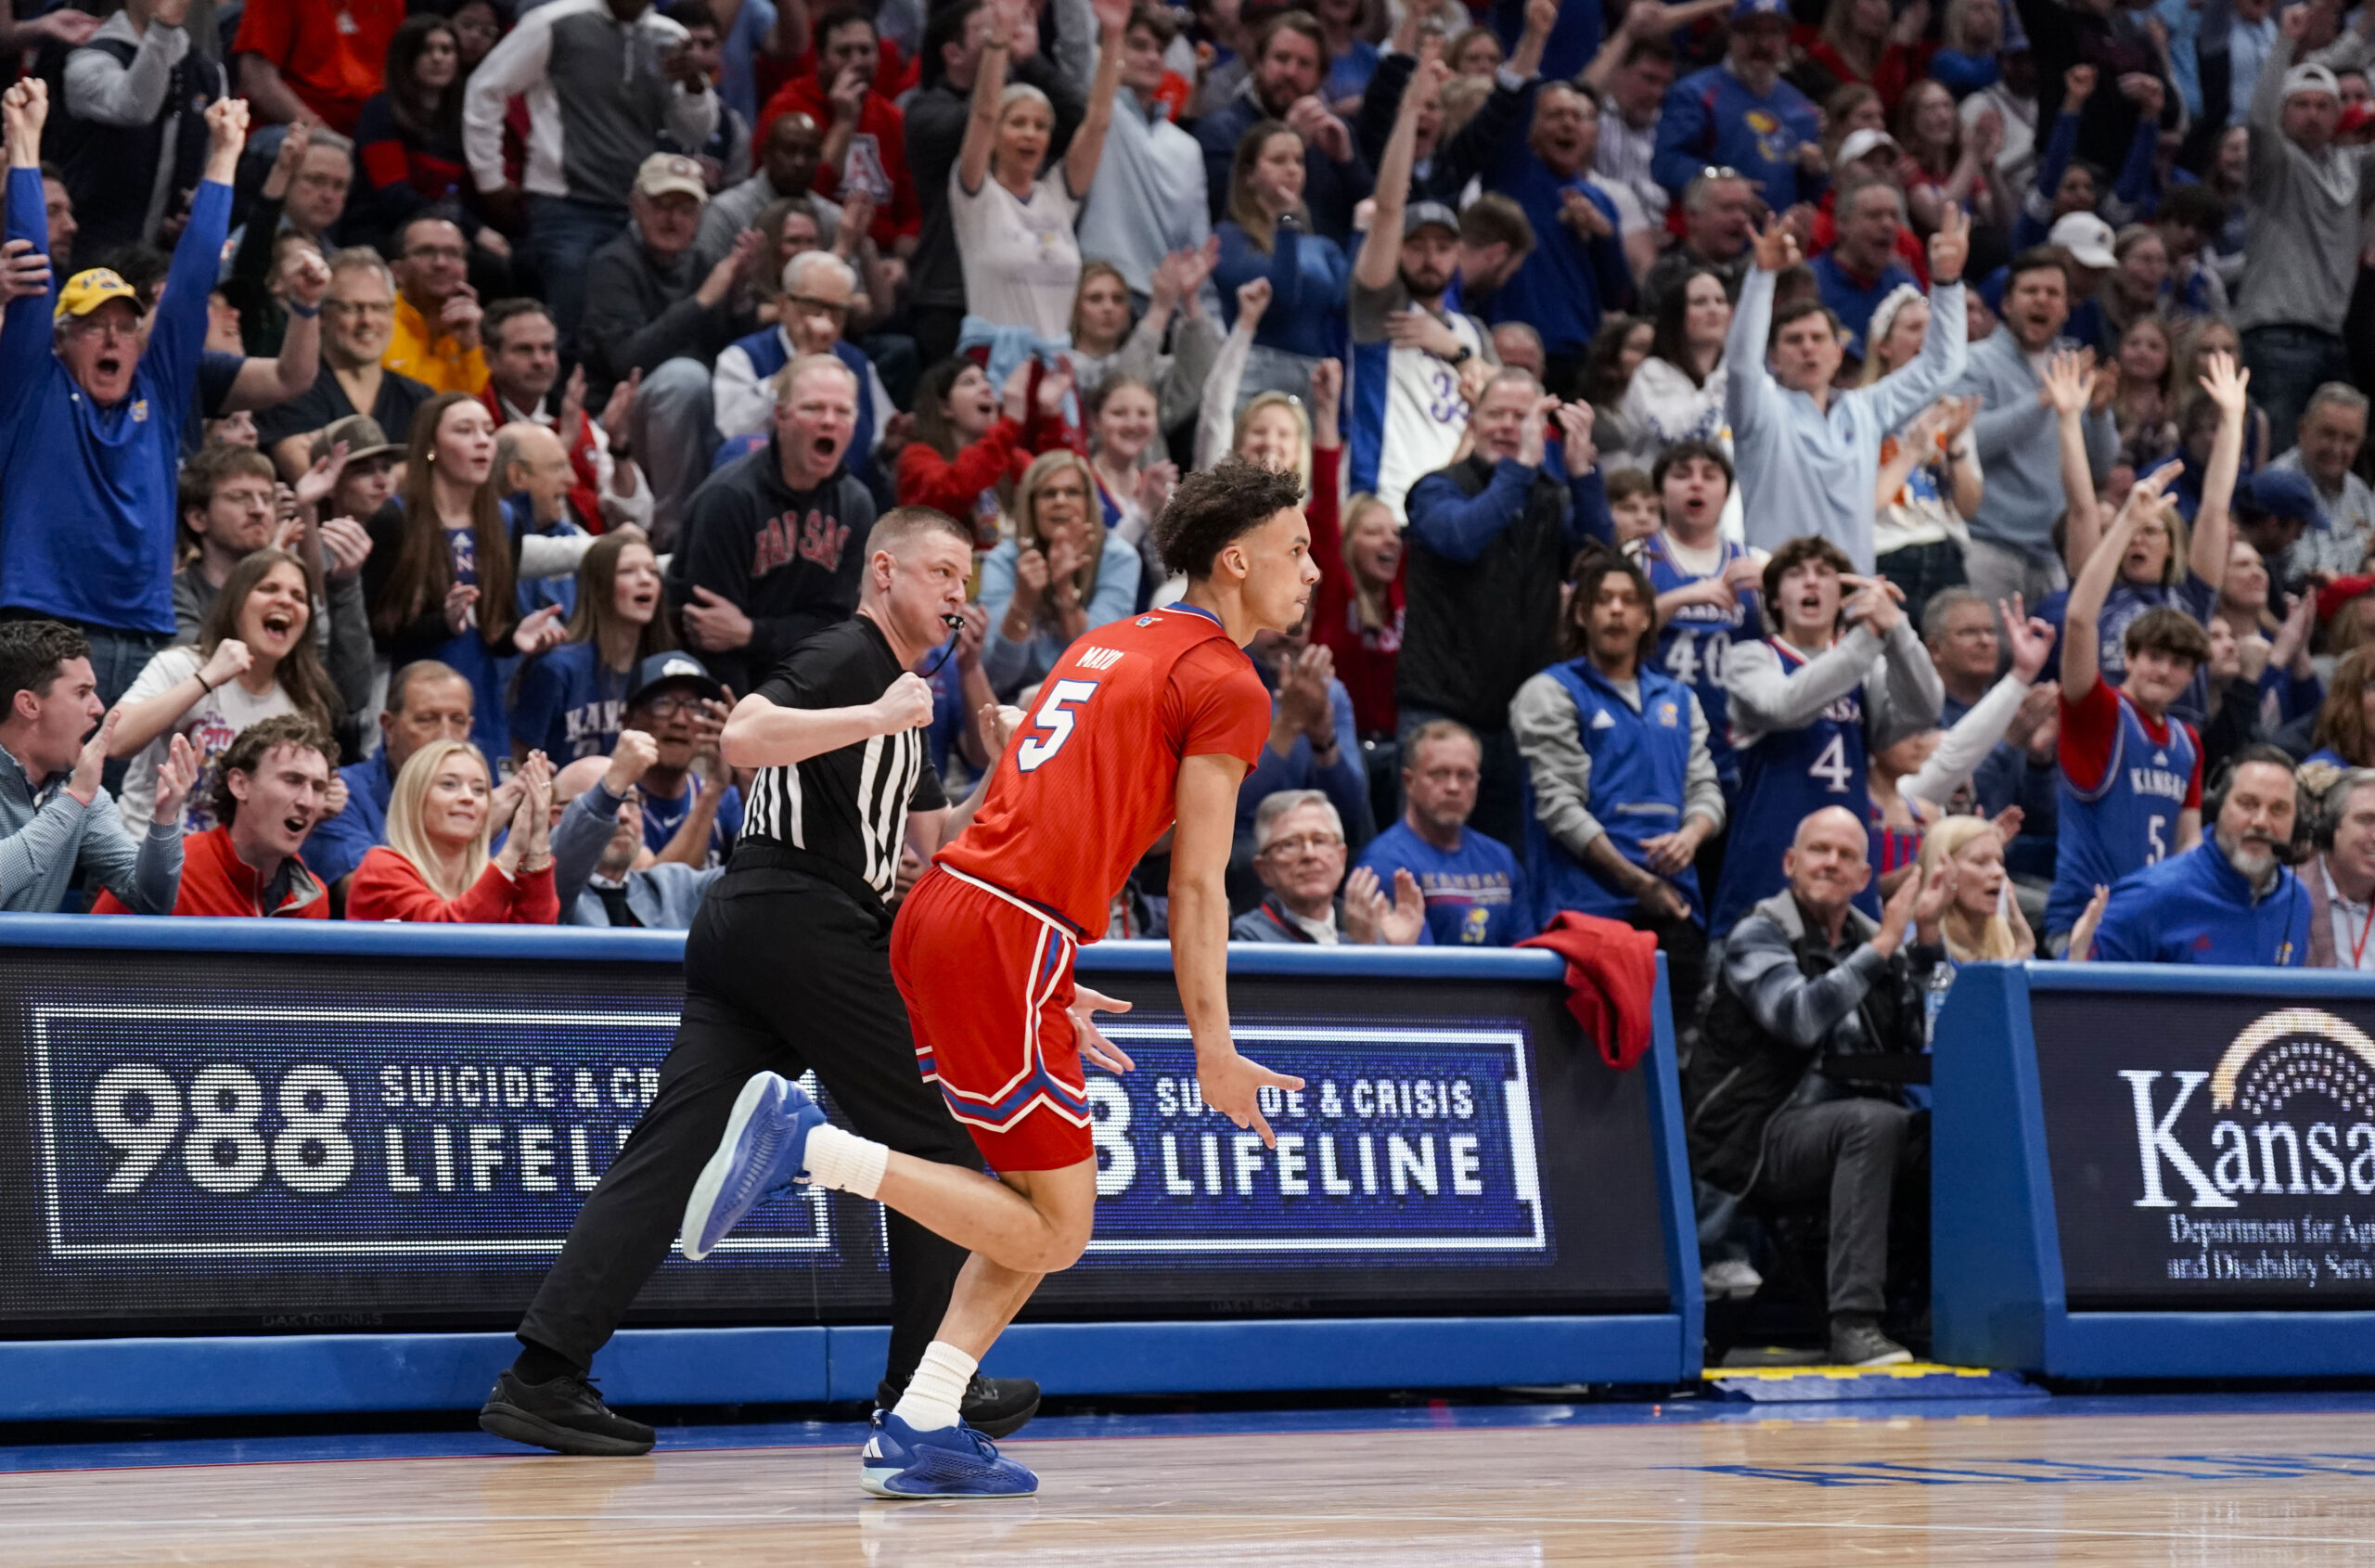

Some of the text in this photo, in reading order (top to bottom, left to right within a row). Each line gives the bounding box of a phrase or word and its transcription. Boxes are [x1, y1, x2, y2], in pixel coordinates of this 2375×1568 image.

[1075, 646, 1124, 671] MAYO
[1017, 677, 1101, 773] 5
[1808, 731, 1853, 793] 4
[379, 1064, 556, 1108] SUICIDE
[1156, 1076, 1475, 1120] SUDE & CRISIS
[91, 1062, 355, 1193] 988
[383, 1124, 633, 1191] LIFEL
[1160, 1130, 1483, 1196] LIFELINE
[2167, 1213, 2296, 1251] Department
[2302, 1212, 2335, 1244] for
